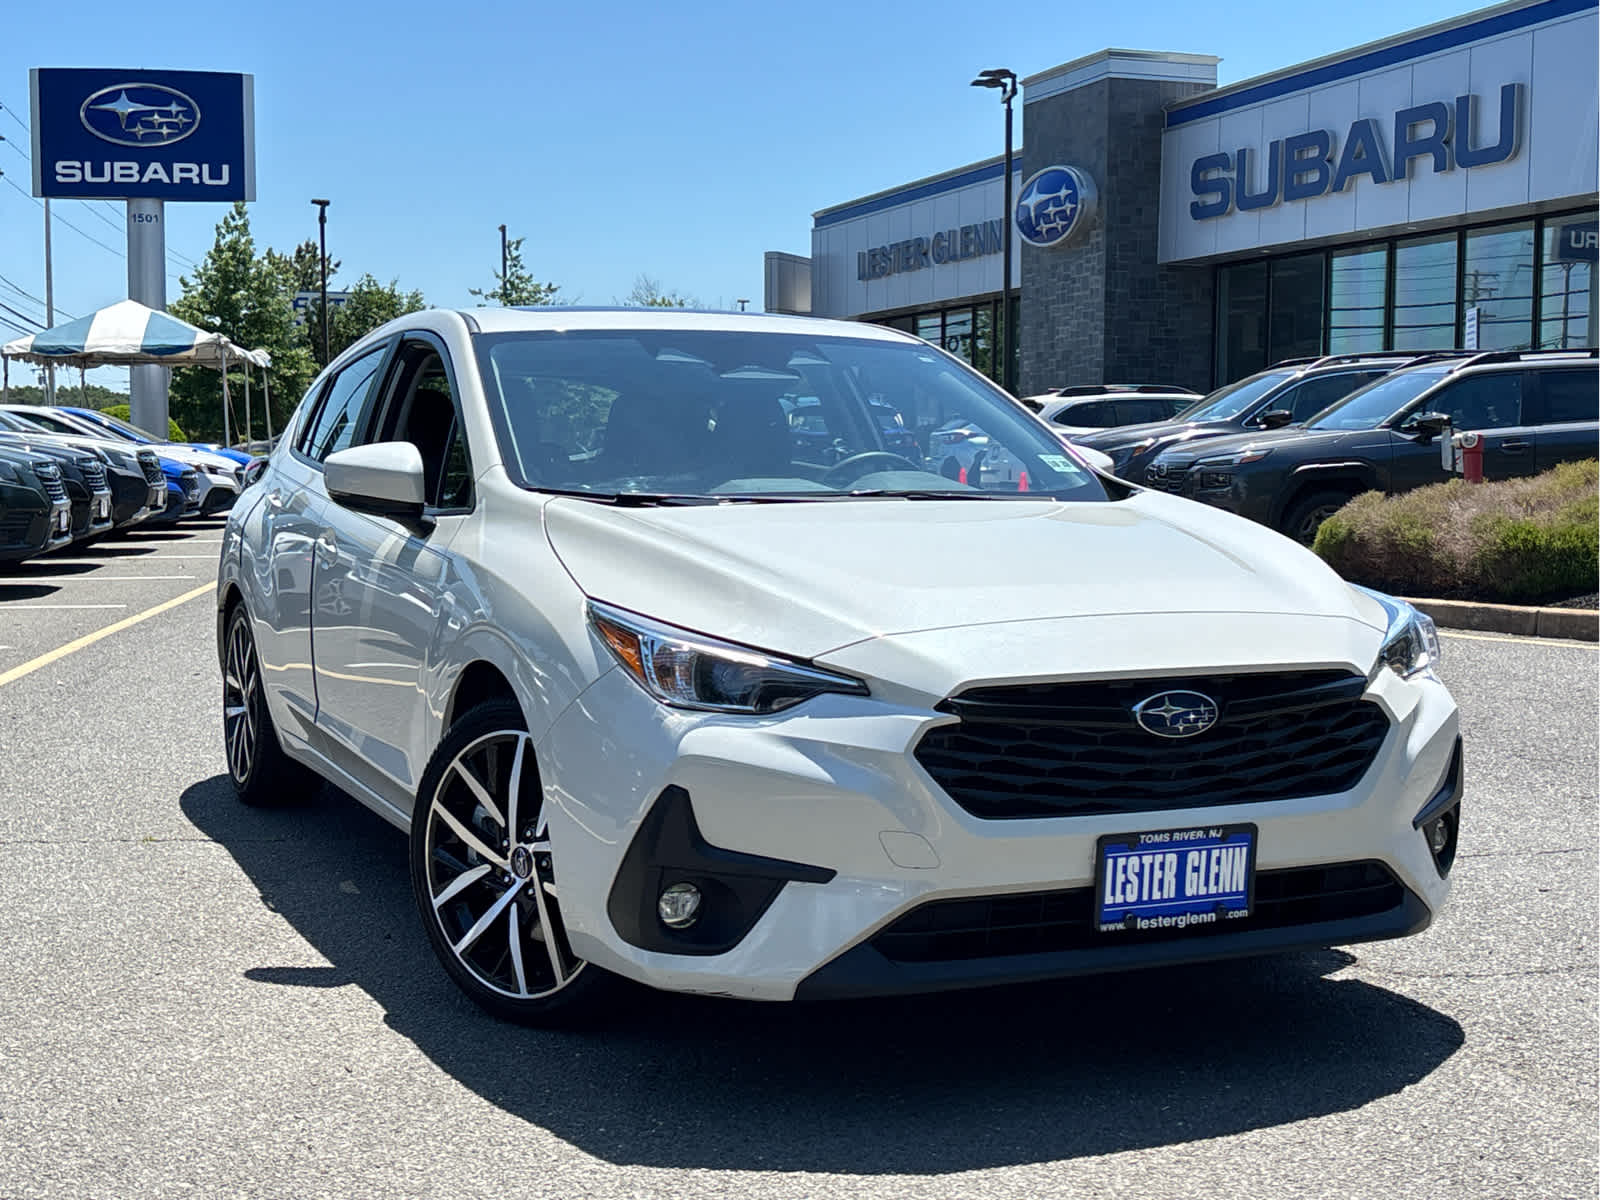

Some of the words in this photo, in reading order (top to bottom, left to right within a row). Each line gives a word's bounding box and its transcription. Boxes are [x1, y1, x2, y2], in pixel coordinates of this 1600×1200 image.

[1190, 82, 1524, 221] SUBARU
[55, 160, 230, 185] SUBARU
[132, 213, 159, 224] 1501
[857, 237, 931, 281] LESTER
[931, 218, 1004, 264] GLENN
[1139, 833, 1171, 844] TOMS
[1208, 828, 1223, 839] NJ
[1104, 853, 1178, 905] LESTER
[1185, 846, 1248, 897] GLENN
[1100, 922, 1126, 932] www.
[1136, 911, 1216, 930] lesterglenn
[1225, 909, 1249, 919] .com
